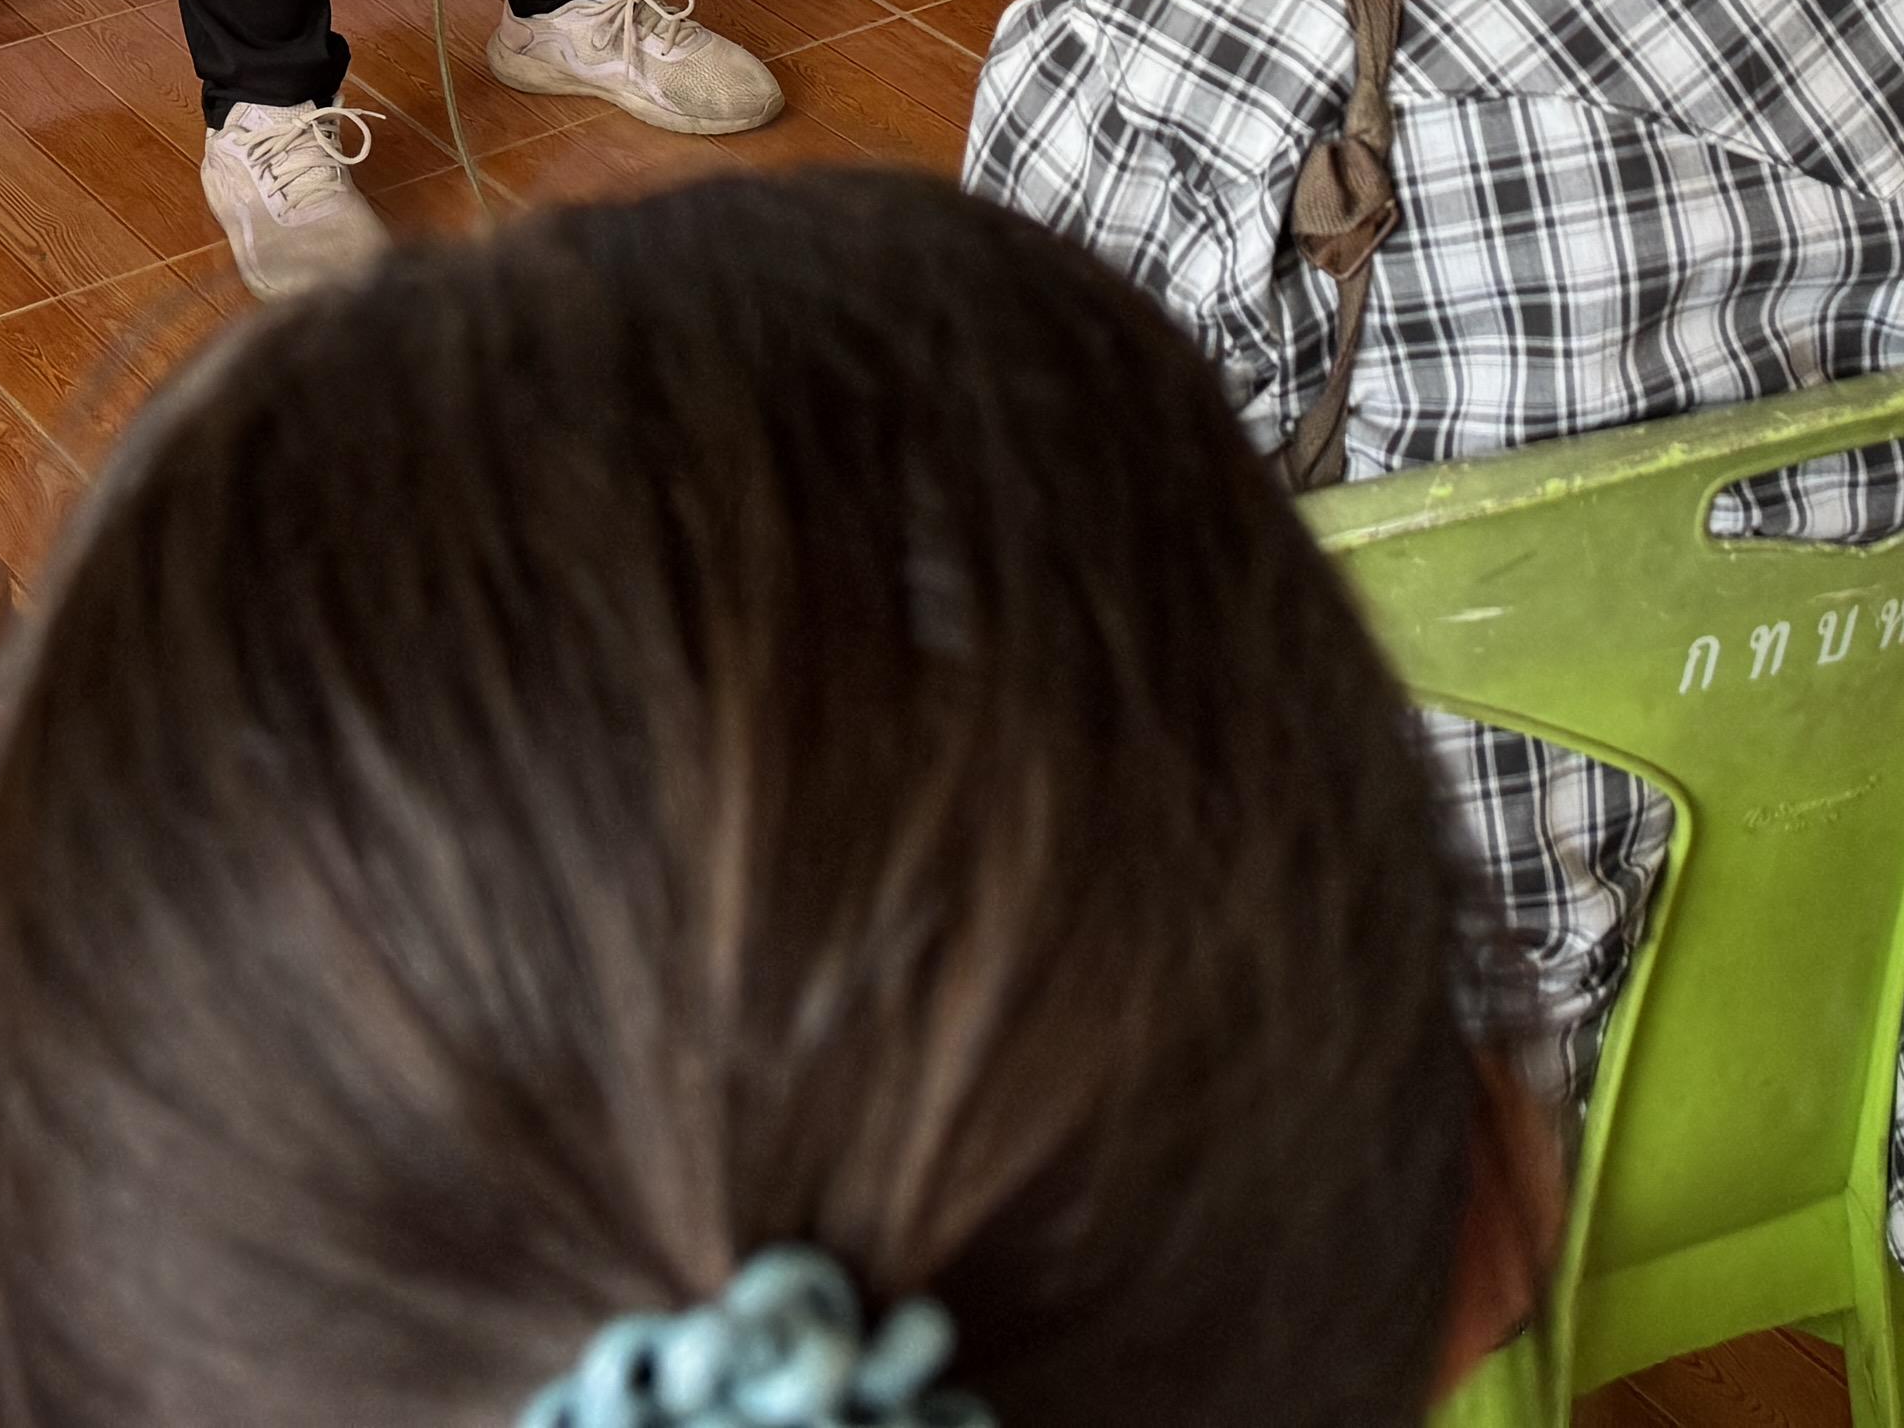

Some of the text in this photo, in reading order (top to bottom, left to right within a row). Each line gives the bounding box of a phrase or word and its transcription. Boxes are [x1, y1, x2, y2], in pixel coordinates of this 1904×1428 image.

[1678, 632, 1720, 695] ก
[1748, 619, 1791, 680] ท
[1816, 604, 1859, 666] บ
